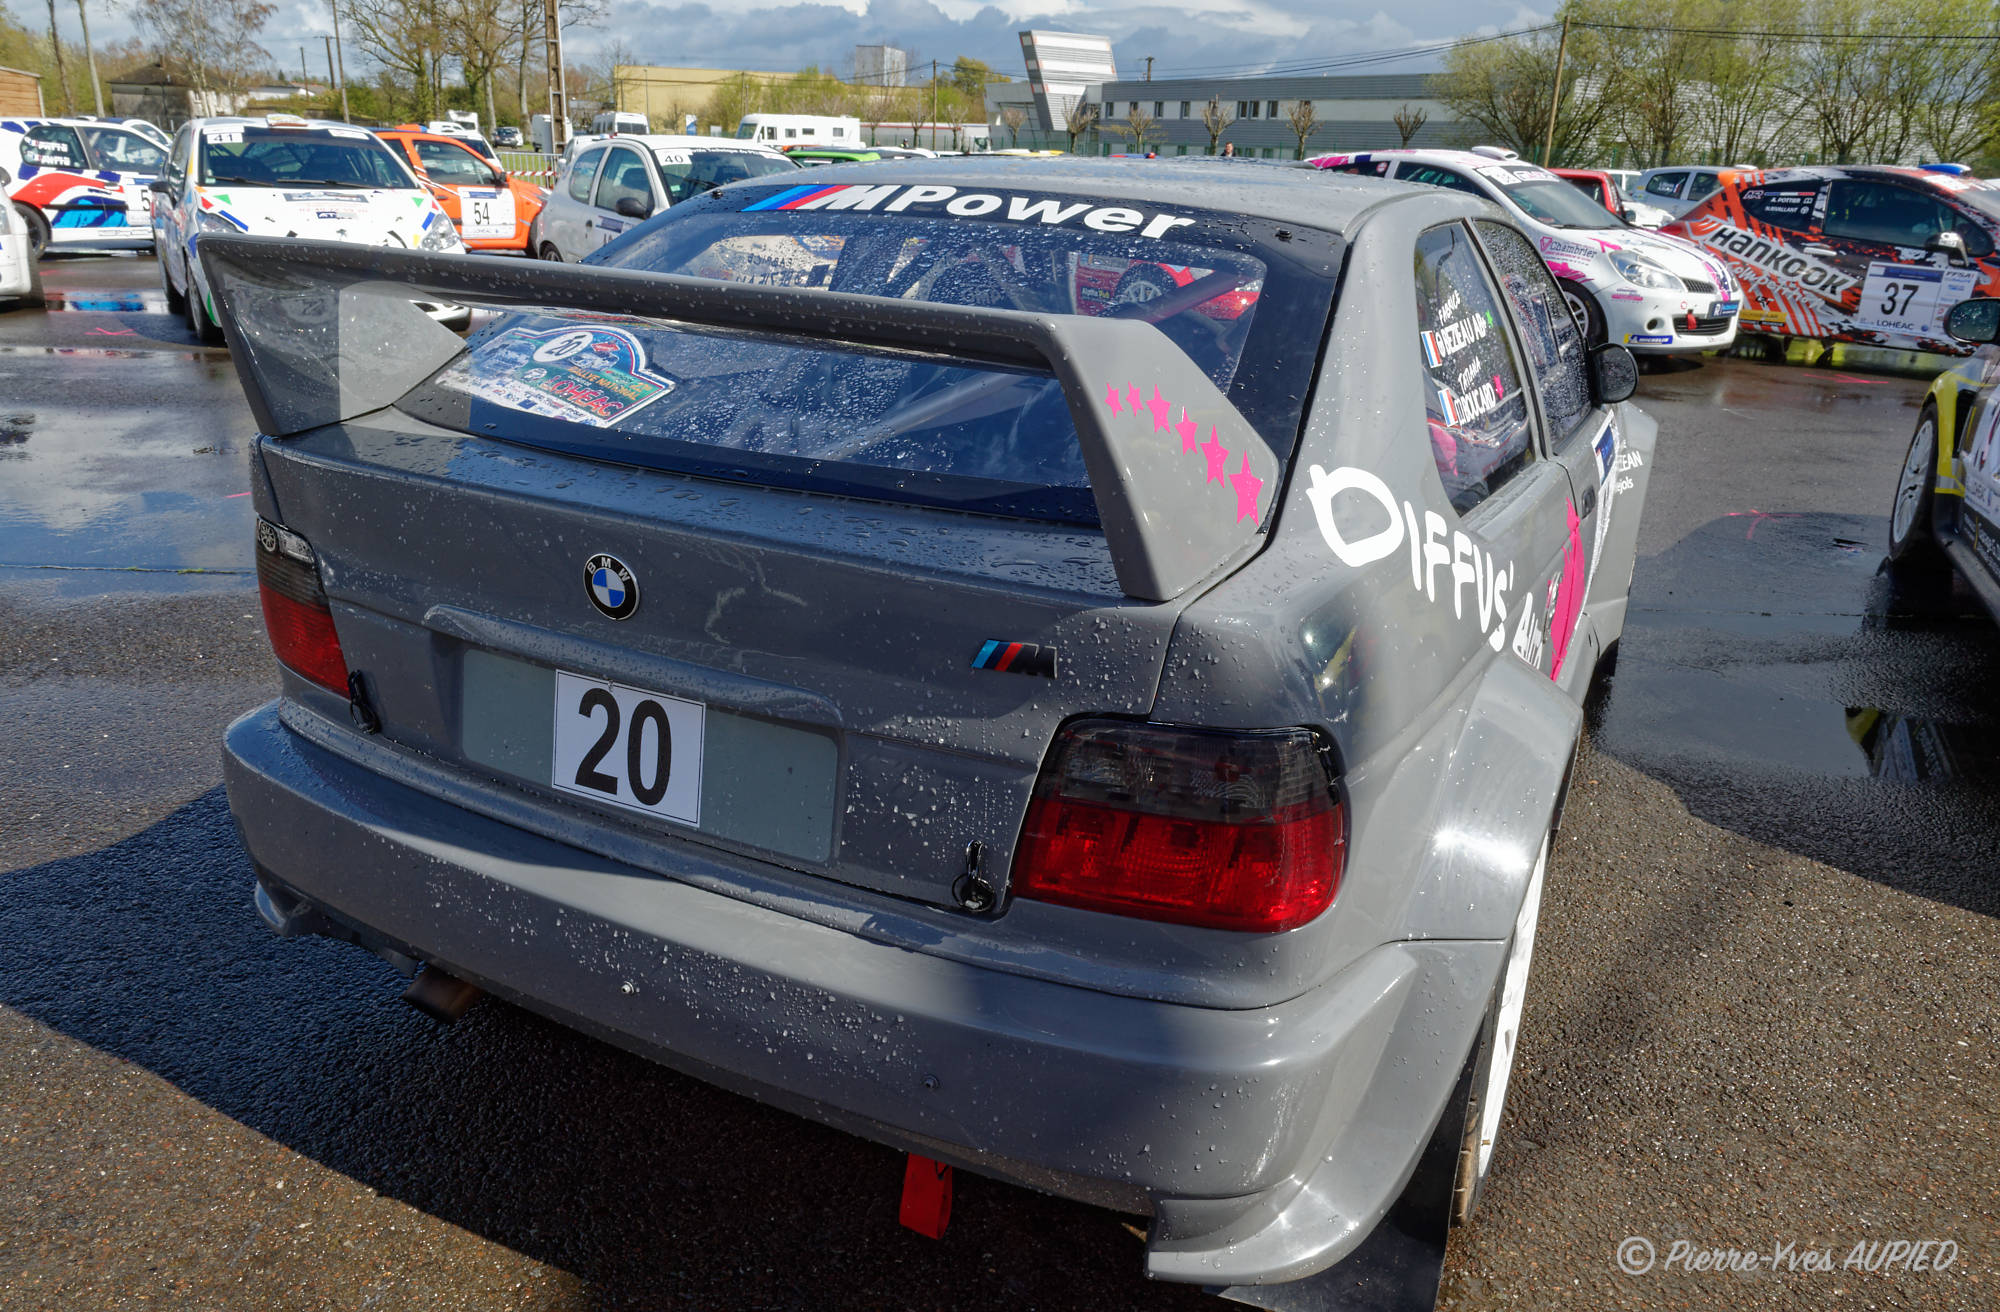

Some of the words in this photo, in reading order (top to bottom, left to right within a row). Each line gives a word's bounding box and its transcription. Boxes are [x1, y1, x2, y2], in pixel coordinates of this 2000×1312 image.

[664, 154, 684, 164] 40
[474, 202, 490, 225] 54
[1549, 240, 1598, 259] Chambrier
[1880, 282, 1920, 317] 37
[586, 556, 631, 582] BMW
[574, 687, 673, 807] 20
